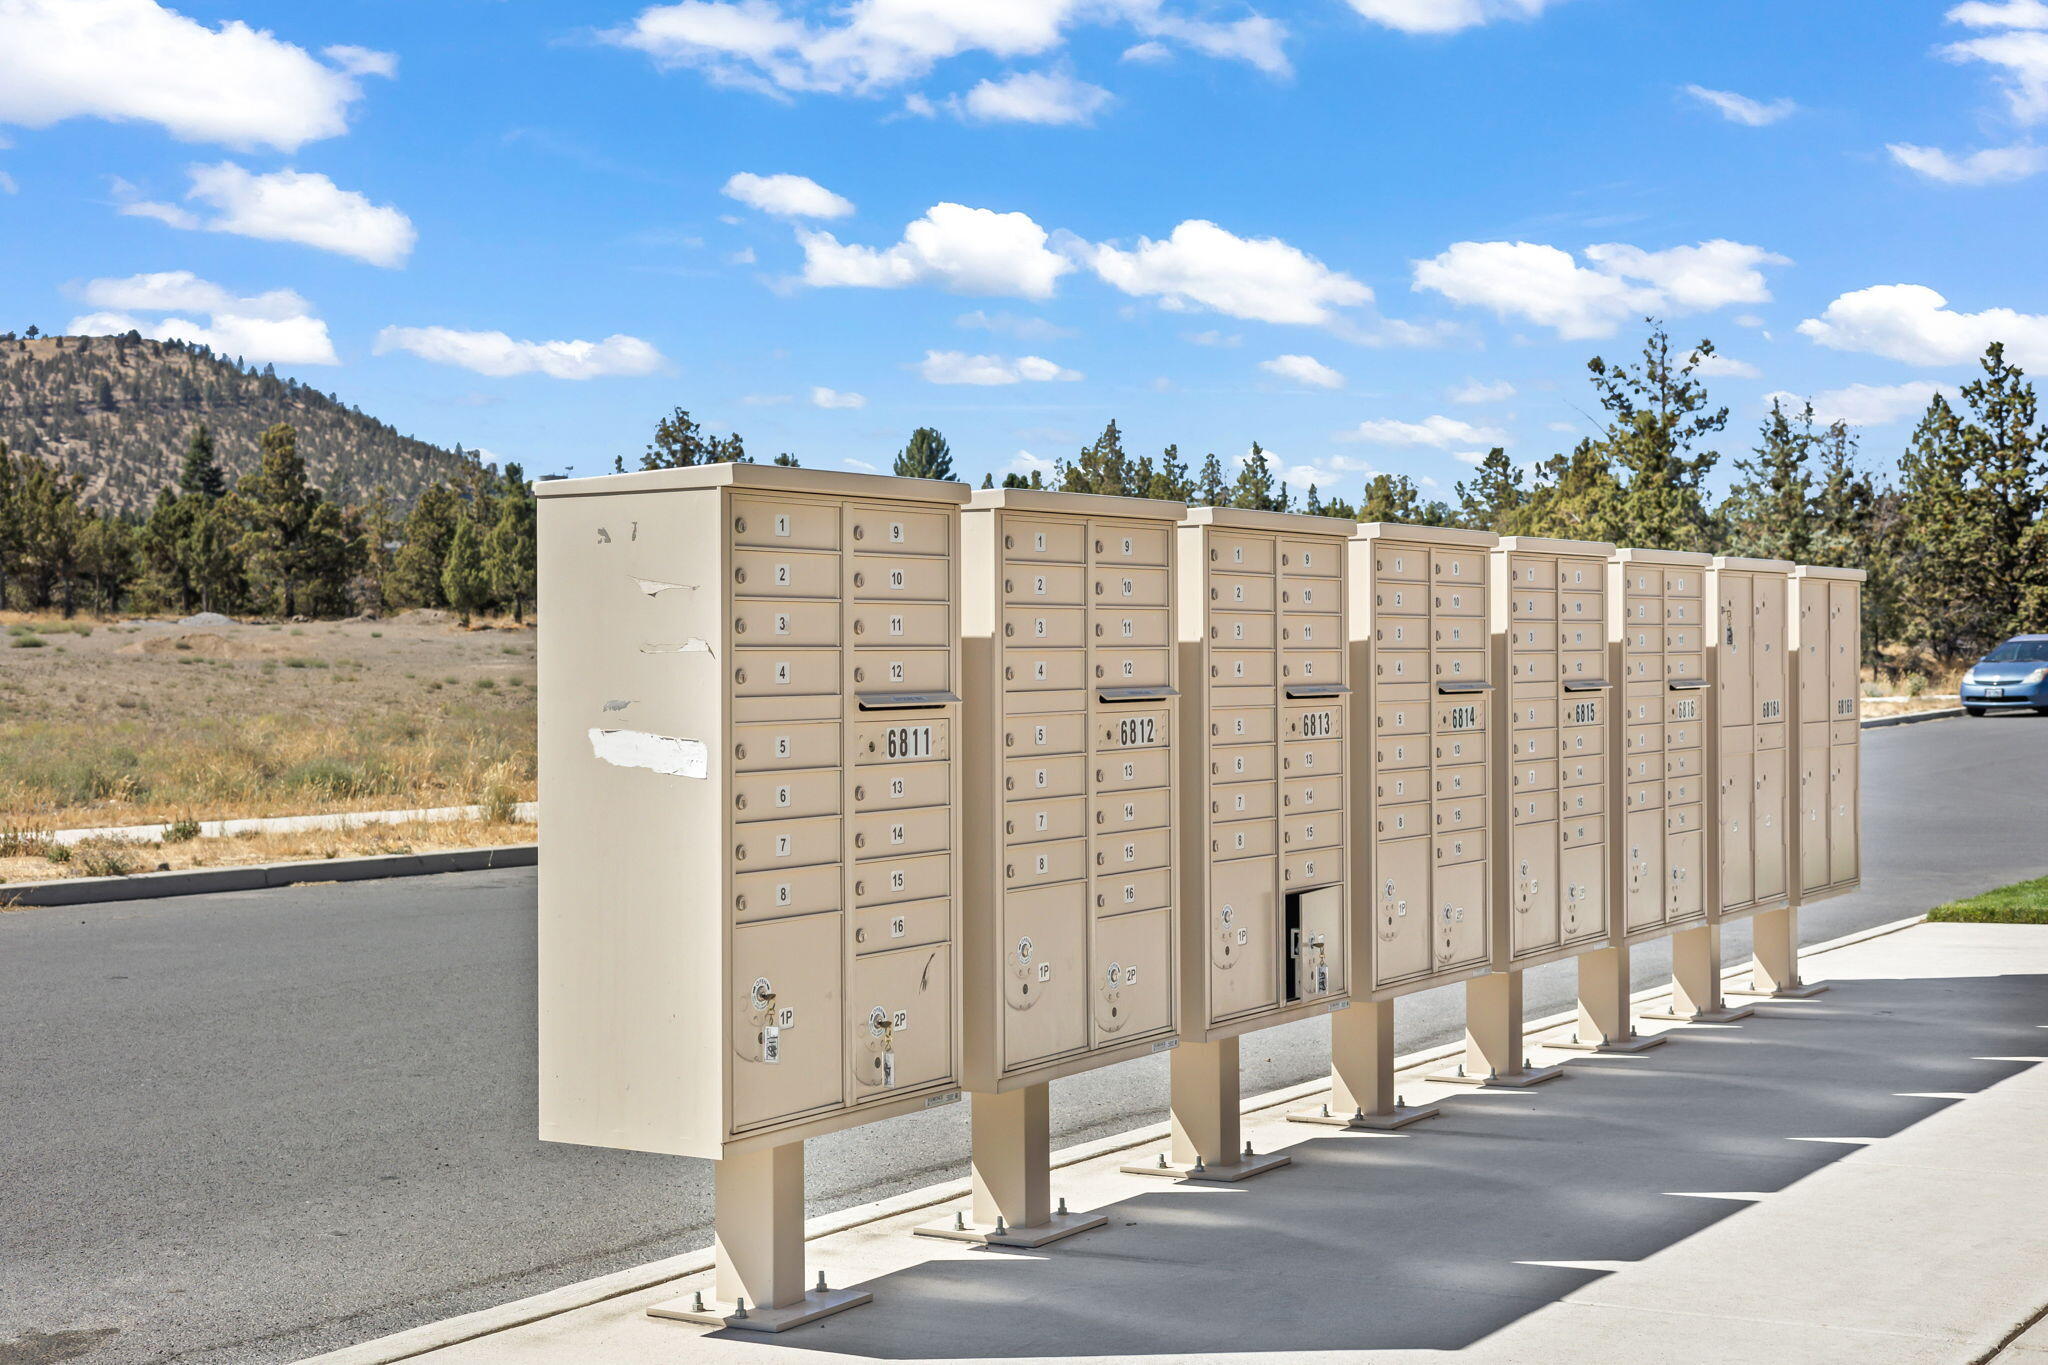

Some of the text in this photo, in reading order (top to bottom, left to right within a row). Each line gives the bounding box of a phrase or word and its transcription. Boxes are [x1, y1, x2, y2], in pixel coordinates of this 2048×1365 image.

[779, 518, 784, 532] 1
[893, 526, 899, 539] 9
[1038, 535, 1042, 548] 1
[1125, 540, 1130, 552] 9
[1236, 549, 1240, 560] 1
[1305, 554, 1310, 565] 9
[779, 567, 785, 581] 2
[892, 572, 902, 585] 10
[1038, 578, 1043, 591] 2
[1123, 581, 1132, 593] 10
[1236, 587, 1241, 598] 2
[1304, 590, 1312, 601] 10
[779, 617, 786, 631] 3
[891, 618, 901, 631] 11
[1038, 621, 1044, 634] 3
[1123, 622, 1131, 634] 11
[1236, 625, 1241, 636] 3
[1304, 627, 1311, 637] 11
[779, 665, 786, 679] 4
[891, 664, 902, 678] 12
[1038, 664, 1043, 676] 4
[1124, 662, 1132, 674] 12
[1237, 663, 1241, 674] 4
[1305, 663, 1312, 674] 12
[1575, 703, 1595, 723] 6815
[1678, 700, 1695, 719] 6816
[1303, 712, 1330, 736] 6813
[1452, 706, 1475, 729] 6814
[1120, 718, 1154, 745] 6812
[1237, 720, 1242, 731] 5
[1038, 728, 1044, 742] 5
[780, 740, 786, 754] 5
[887, 727, 931, 758] 6811
[1237, 758, 1242, 770] 6
[1306, 754, 1313, 765] 13
[1124, 764, 1133, 777] 13
[1038, 772, 1044, 784] 6
[892, 780, 903, 794] 13
[780, 789, 786, 803] 6
[1238, 796, 1242, 807] 7
[1306, 790, 1313, 800] 14
[1125, 805, 1133, 817] 14
[1039, 815, 1044, 827] 7
[892, 827, 903, 840] 14
[1306, 826, 1313, 837] 15
[780, 838, 786, 852] 7
[1238, 835, 1242, 846] 8
[1125, 846, 1134, 858] 15
[1039, 857, 1045, 870] 8
[1307, 863, 1314, 874] 16
[893, 873, 903, 887] 15
[780, 887, 787, 901] 8
[1126, 887, 1134, 899] 16
[893, 919, 904, 933] 16
[1238, 930, 1247, 943] 1P
[1039, 965, 1049, 978] 1P
[1126, 969, 1136, 981] 2P
[780, 1010, 793, 1025] 1P
[894, 1012, 906, 1027] 2P
